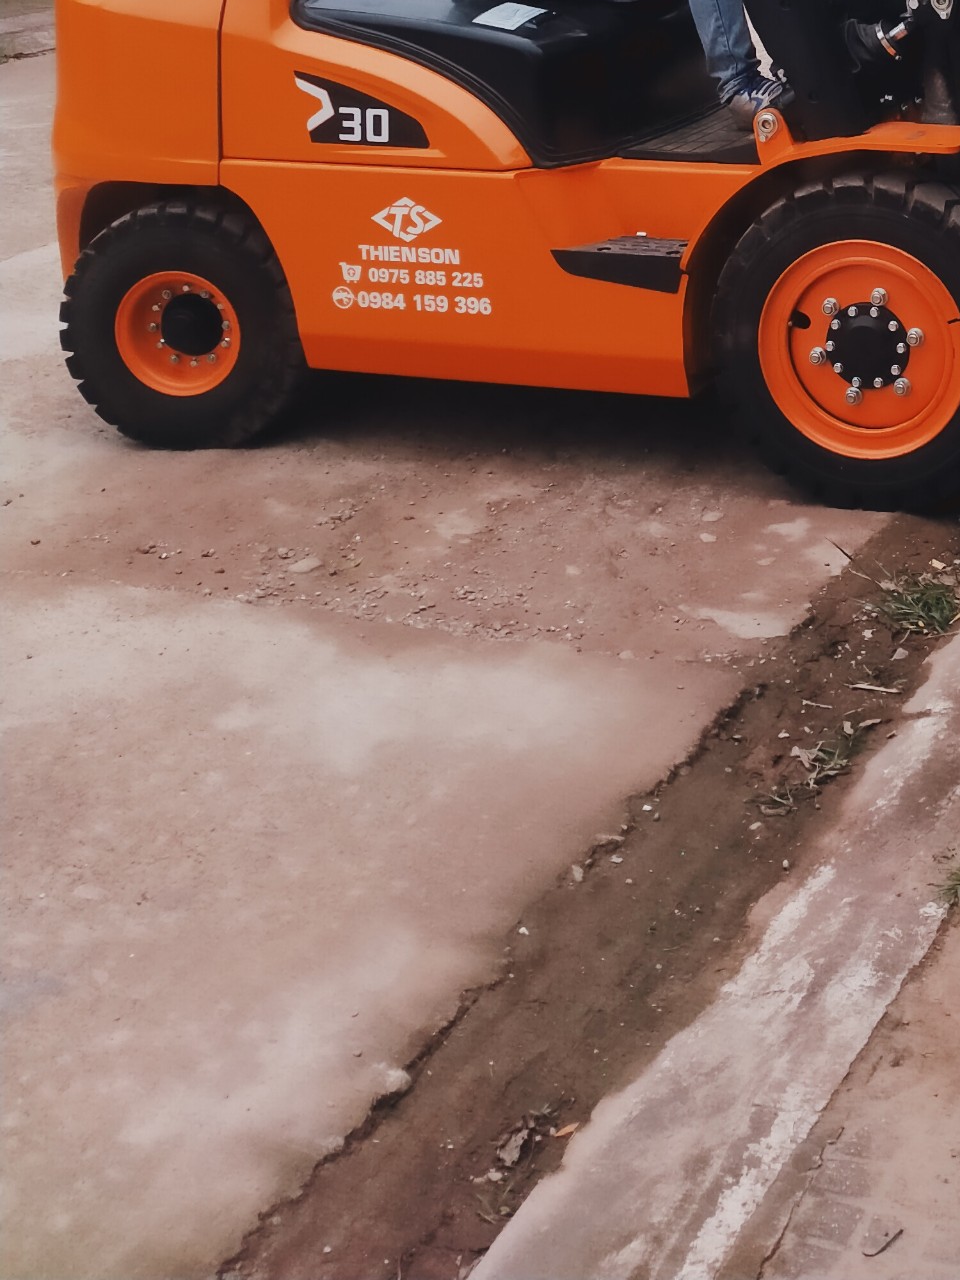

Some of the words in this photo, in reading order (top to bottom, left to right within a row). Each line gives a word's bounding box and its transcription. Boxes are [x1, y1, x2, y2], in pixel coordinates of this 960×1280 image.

[358, 244, 460, 265] THIENSON
[368, 267, 410, 285] 0975
[415, 269, 446, 286] 885
[451, 272, 484, 288] 225
[357, 291, 406, 310] 0984
[413, 294, 449, 312] 159
[454, 296, 492, 315] 396
